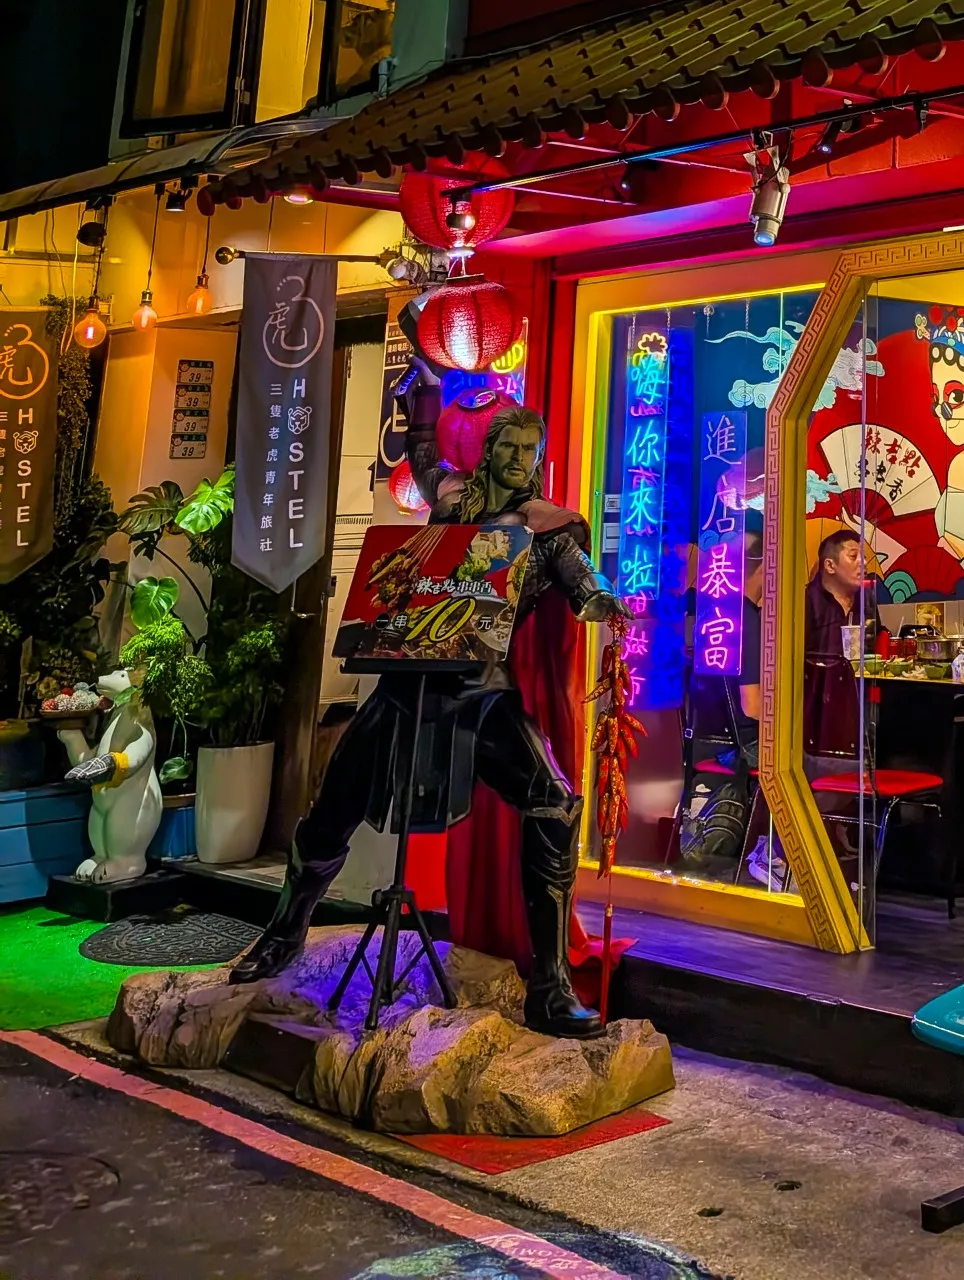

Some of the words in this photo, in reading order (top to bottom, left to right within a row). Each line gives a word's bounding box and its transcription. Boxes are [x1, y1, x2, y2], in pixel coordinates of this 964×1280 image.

[188, 372, 201, 383] 39
[186, 397, 199, 407] 39
[184, 422, 197, 432] 39
[182, 446, 195, 457] 39
[259, 383, 283, 553] 三隻老虎青年旅社
[700, 415, 743, 669] 進店暴富
[404, 598, 476, 642] 10
[478, 616, 491, 630] 元
